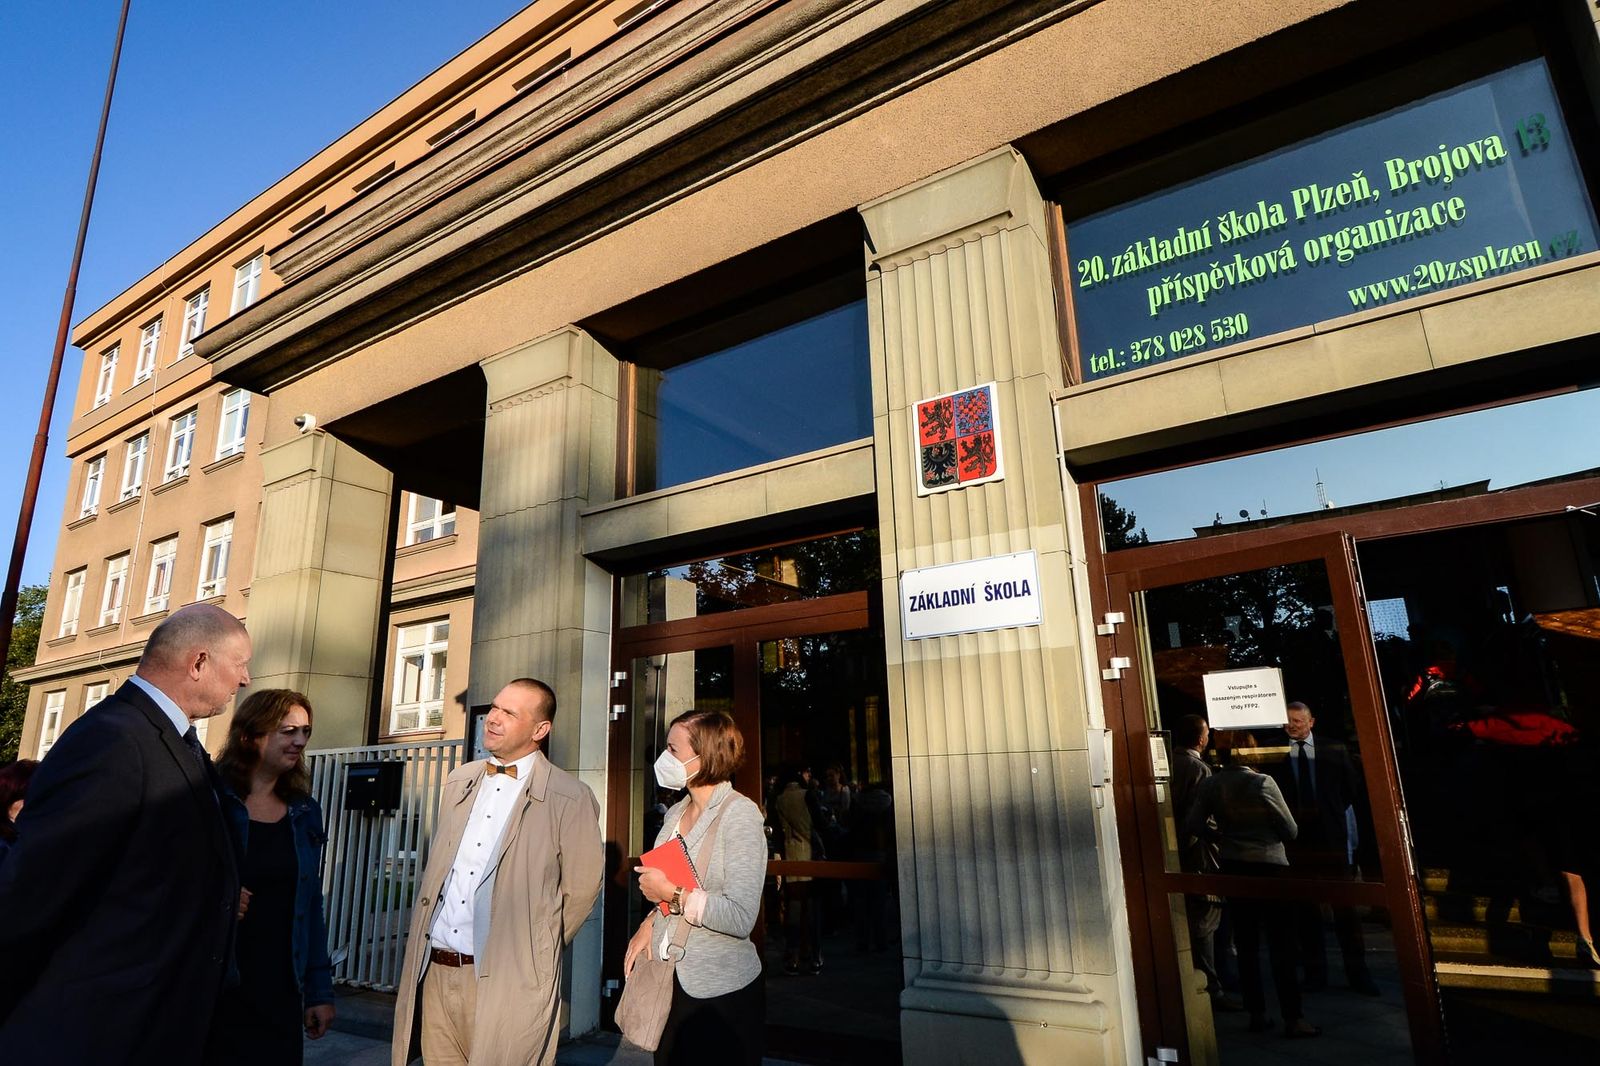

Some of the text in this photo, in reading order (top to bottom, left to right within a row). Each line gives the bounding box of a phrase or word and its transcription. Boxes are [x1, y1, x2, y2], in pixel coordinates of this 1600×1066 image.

[1217, 200, 1288, 244] škola
[1290, 169, 1380, 220] Plzeň,
[1383, 134, 1508, 191] Brojova
[1514, 111, 1552, 153] 13
[1146, 196, 1467, 317] příspěvková organizace
[1089, 312, 1249, 374] tel.: 378 028 530
[909, 579, 1032, 613] ZÁKLADNÍ ŠKOLA
